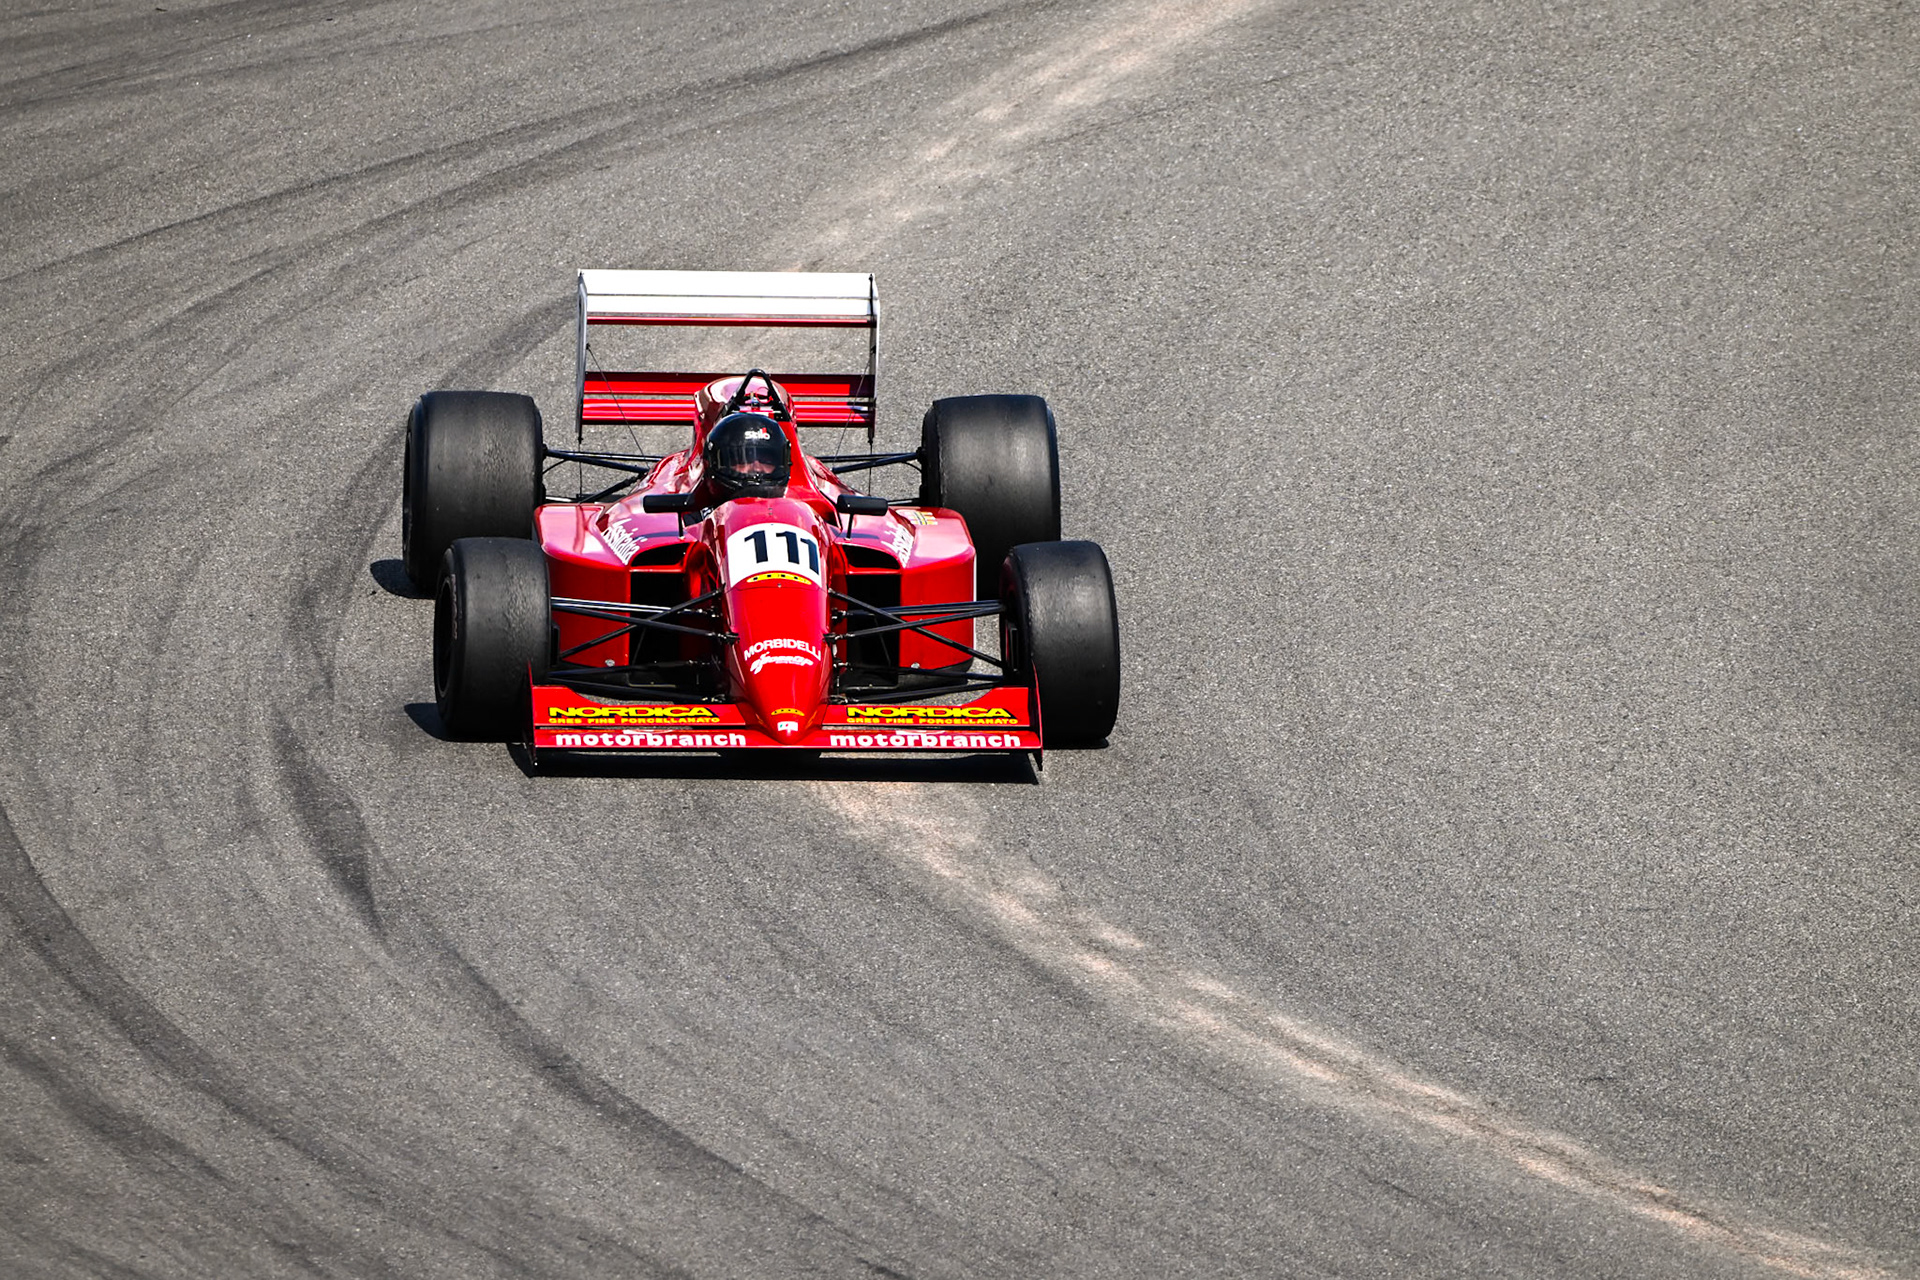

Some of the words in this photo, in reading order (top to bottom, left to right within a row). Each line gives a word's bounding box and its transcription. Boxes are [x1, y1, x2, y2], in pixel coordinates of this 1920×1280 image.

[744, 530, 820, 576] 111
[744, 638, 821, 662] MORBIDELLI
[548, 707, 716, 717] NORDICA
[846, 707, 1014, 718] NORDICA
[556, 733, 746, 746] motorbranch
[830, 734, 1021, 747] motorbranch
